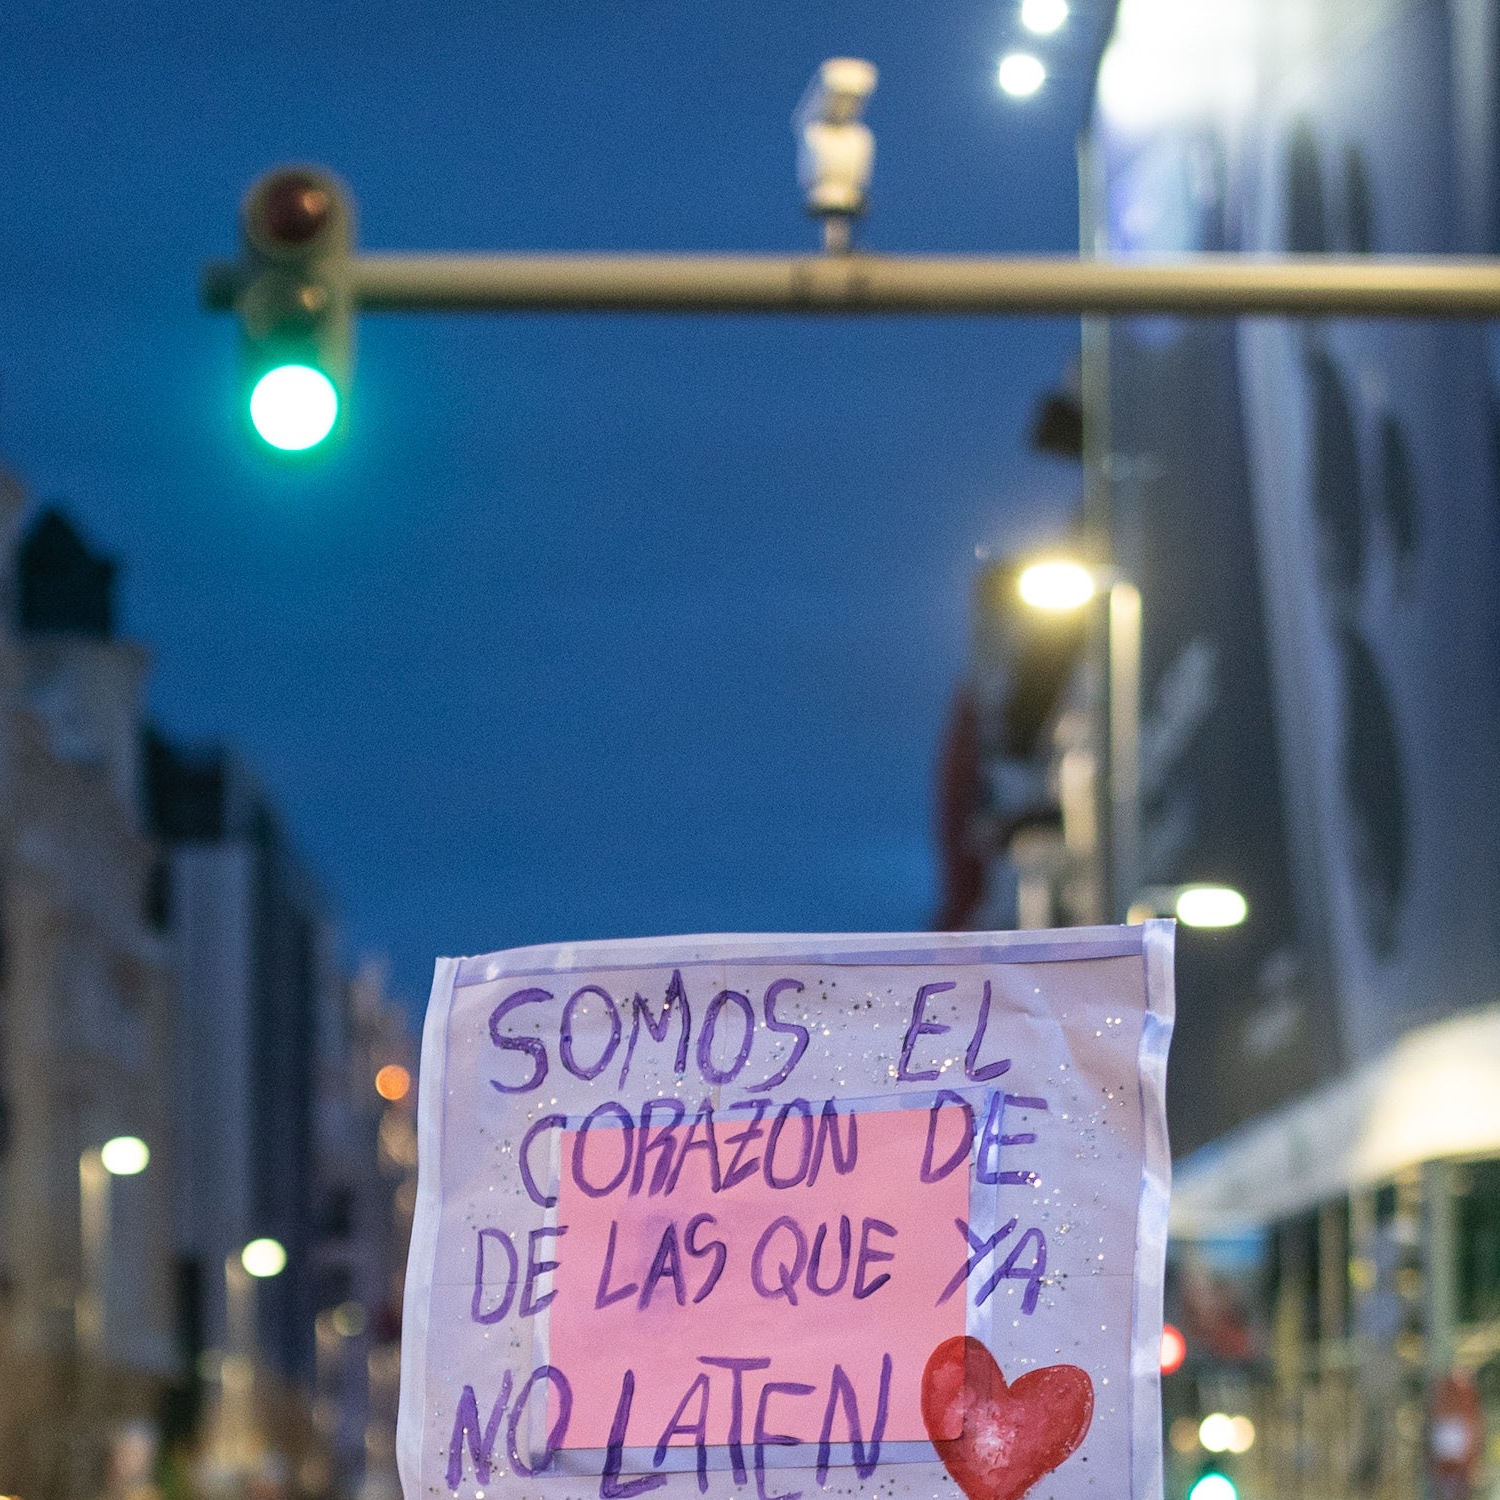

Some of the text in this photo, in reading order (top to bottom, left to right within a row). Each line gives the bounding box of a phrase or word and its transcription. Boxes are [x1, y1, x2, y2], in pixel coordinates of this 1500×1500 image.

[488, 968, 1012, 1095] SOMOS EL
[518, 1090, 1049, 1209] CORAZON DE
[470, 1212, 1050, 1327] DE LAS QUE YA
[445, 1364, 574, 1490] NO
